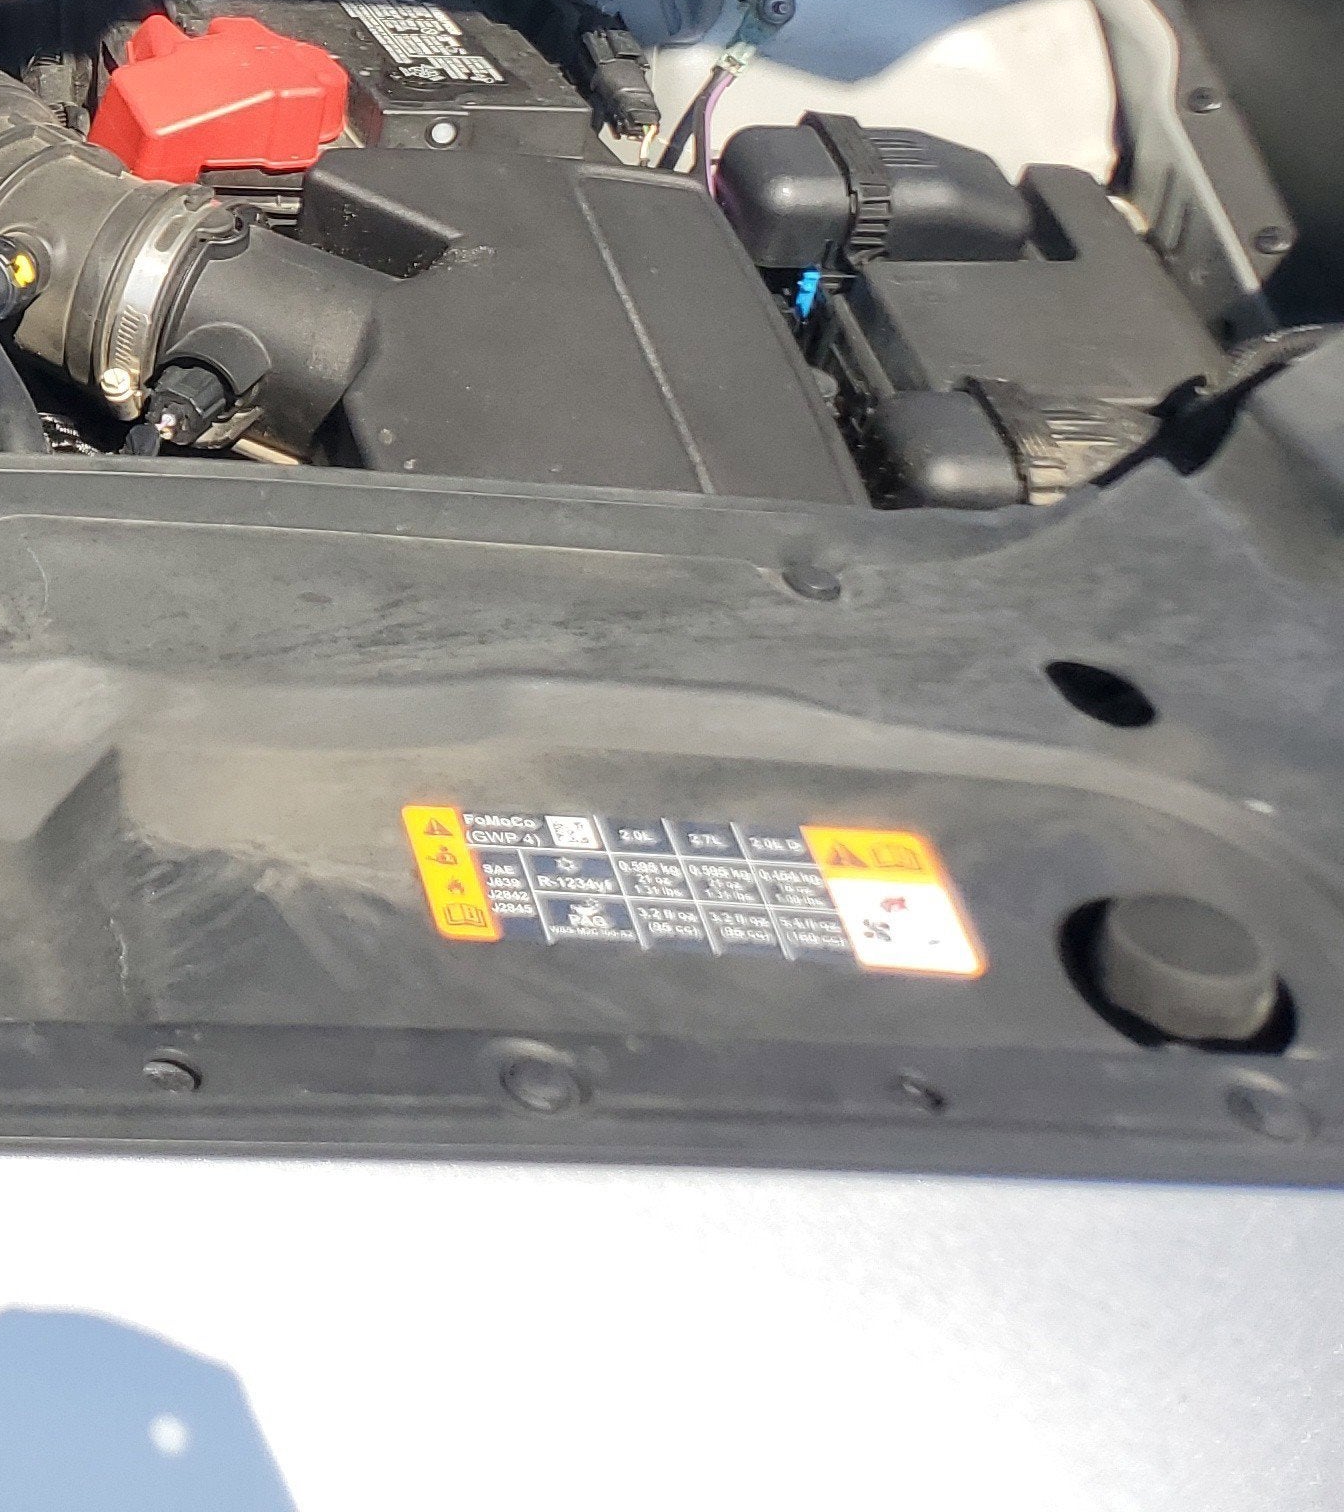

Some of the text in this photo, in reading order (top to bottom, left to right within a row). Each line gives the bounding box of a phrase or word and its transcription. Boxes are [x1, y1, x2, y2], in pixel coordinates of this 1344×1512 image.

[462, 813, 536, 828] FoMoCo
[465, 830, 541, 847] (GWP 4)
[482, 864, 515, 875] SAE
[537, 875, 613, 892] R-1234yf
